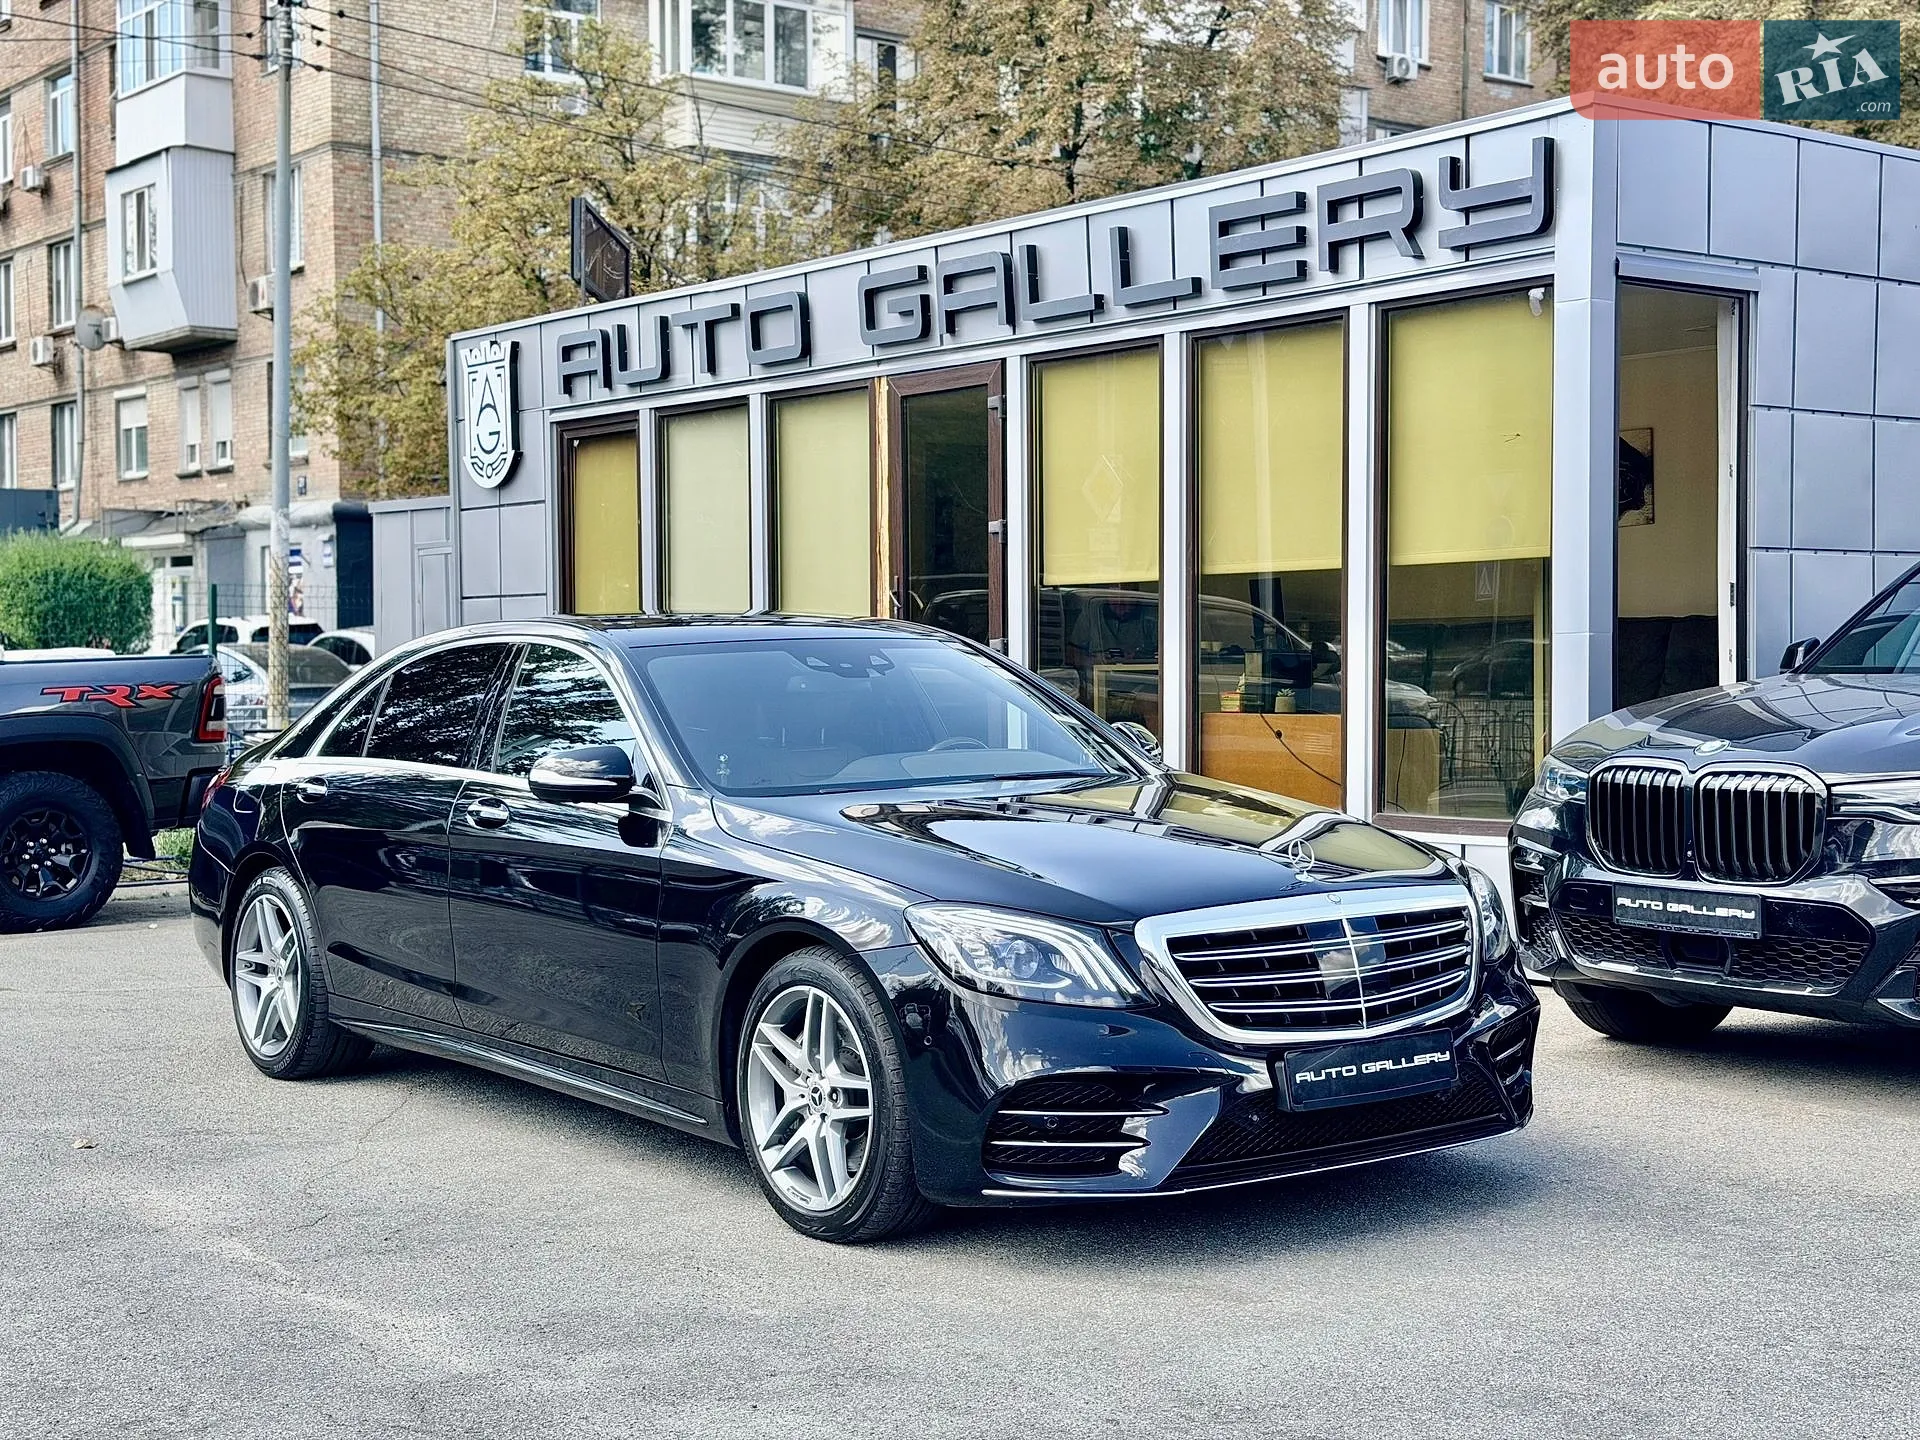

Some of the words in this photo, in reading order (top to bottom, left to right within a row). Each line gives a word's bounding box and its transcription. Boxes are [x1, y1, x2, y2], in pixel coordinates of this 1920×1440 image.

[557, 290, 810, 396] AUTO
[858, 136, 1555, 346] GALLERY
[41, 683, 185, 709] TRX
[1617, 897, 1663, 911] AUTO
[1667, 903, 1755, 919] GALLERY
[1296, 1066, 1356, 1083] AUTO
[1362, 1051, 1450, 1073] GALLERY
